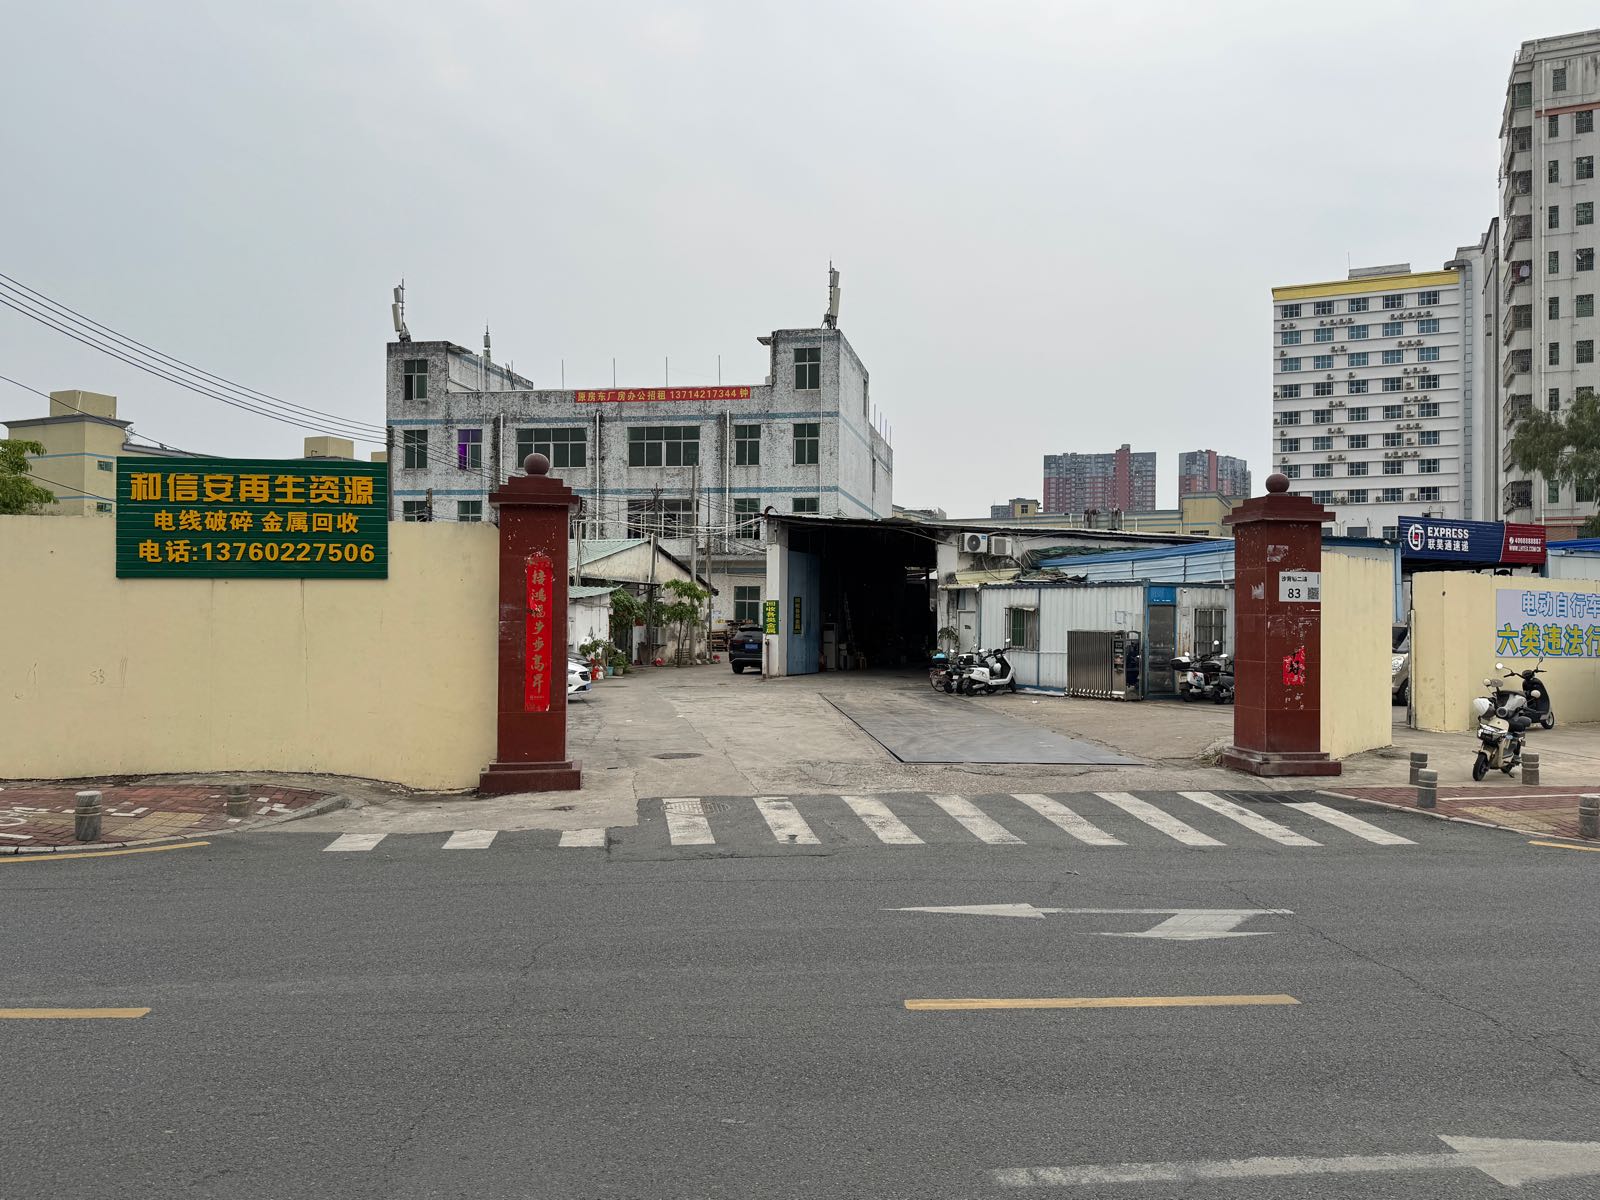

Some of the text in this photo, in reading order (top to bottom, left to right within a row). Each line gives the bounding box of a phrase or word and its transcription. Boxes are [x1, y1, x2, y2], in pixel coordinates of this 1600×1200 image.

[577, 390, 666, 402] 原房东厂房办公招租
[670, 389, 737, 400] 13714217344
[130, 472, 374, 505] 和信安再生资源
[154, 510, 360, 534] 电线破碎 金属回收
[1427, 526, 1469, 539] EXPRESS
[138, 540, 375, 563] 电话:13760227506
[1287, 588, 1301, 599] 83
[1521, 590, 1600, 618] 电动自行车
[1496, 622, 1600, 658] 六类违法行
